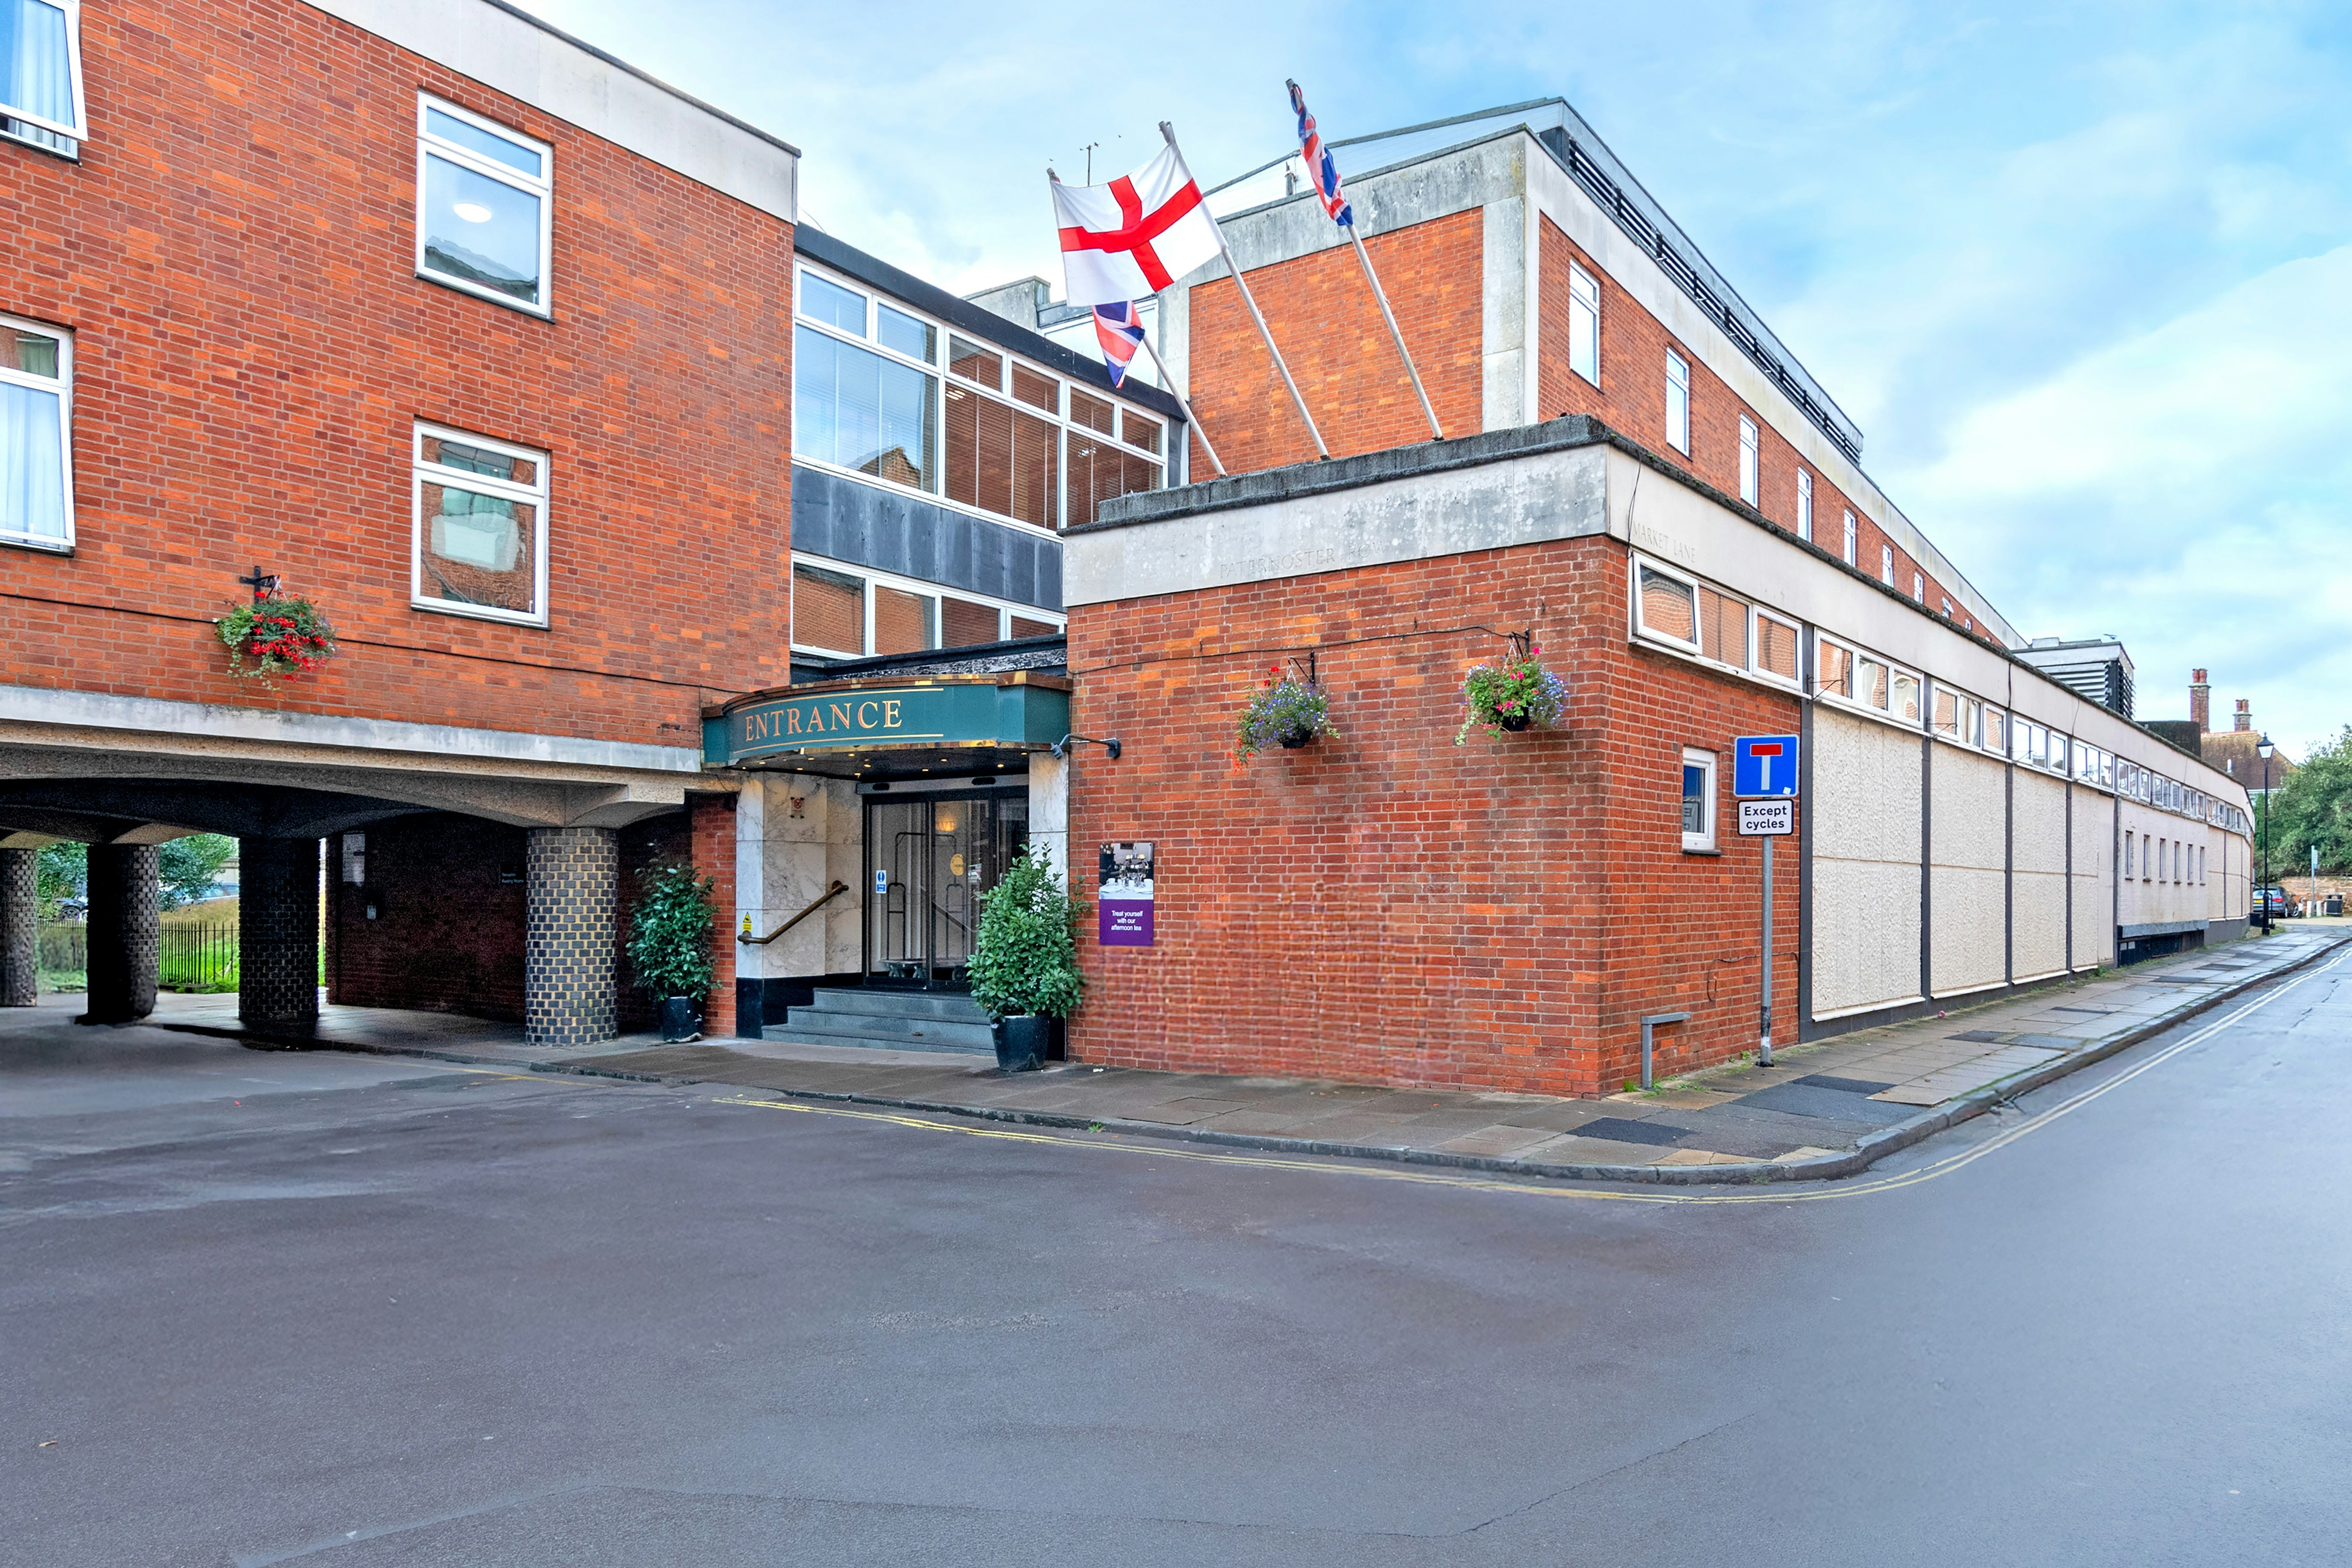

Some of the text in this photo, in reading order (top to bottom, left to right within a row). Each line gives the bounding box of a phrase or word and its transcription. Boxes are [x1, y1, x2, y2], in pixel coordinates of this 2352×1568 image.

[1220, 541, 1391, 578] PATERNOSTER ROW
[1632, 520, 1695, 563] MARKET LANE
[745, 700, 902, 741] ENTRANCE
[1744, 805, 1787, 817] Except
[1746, 819, 1784, 830] cycles
